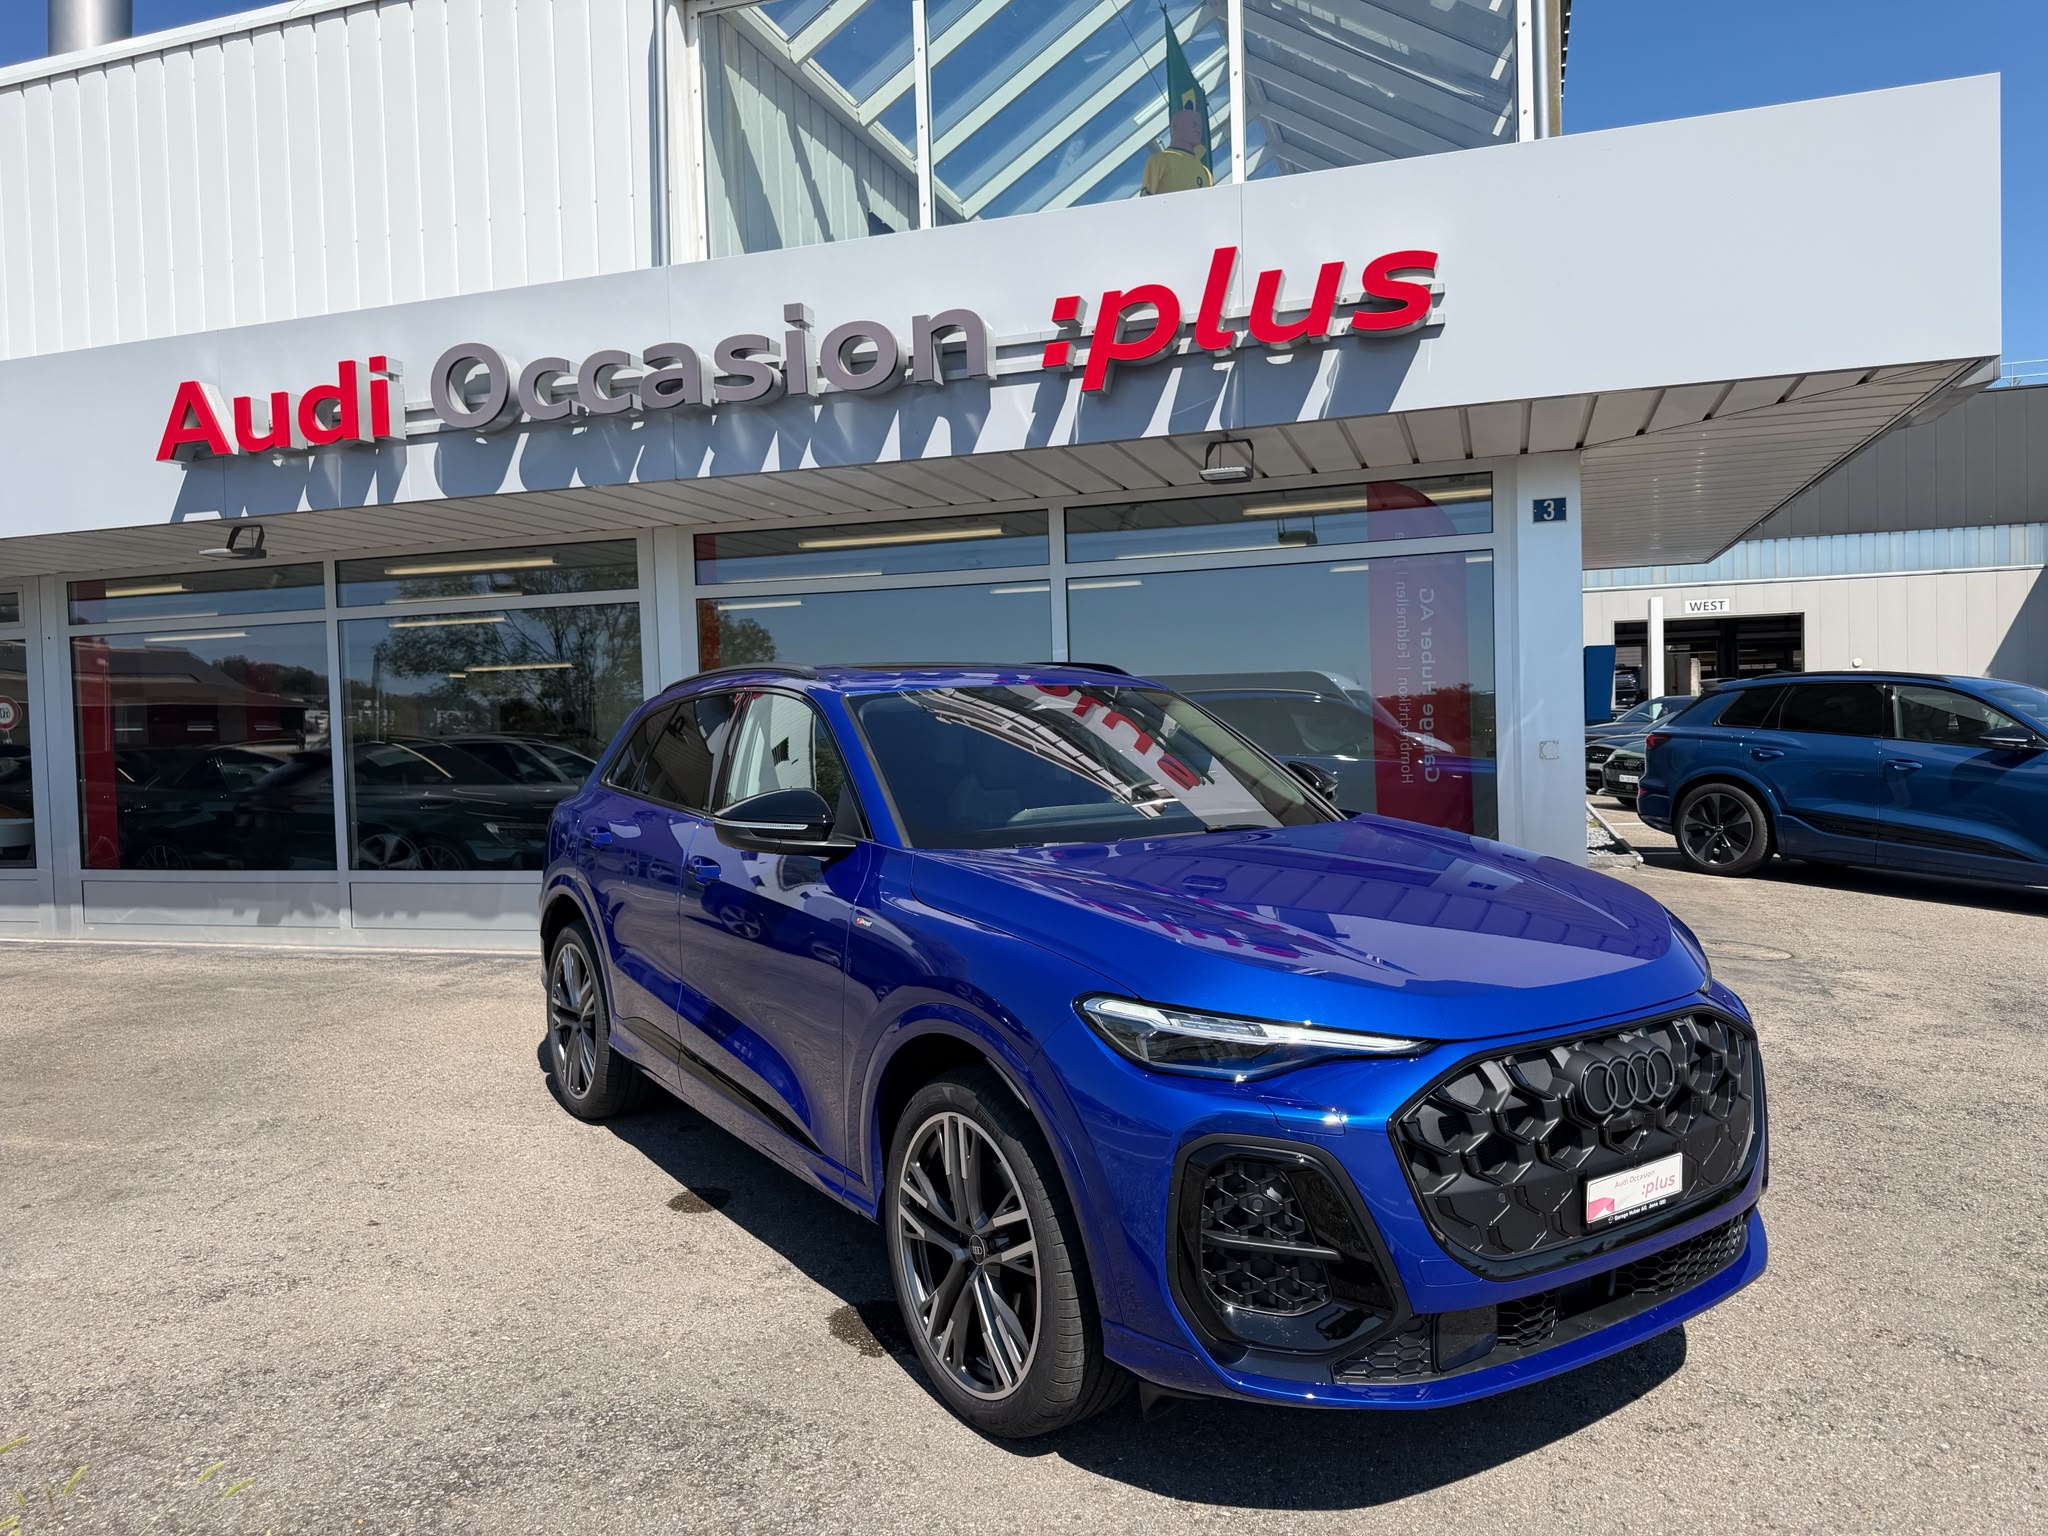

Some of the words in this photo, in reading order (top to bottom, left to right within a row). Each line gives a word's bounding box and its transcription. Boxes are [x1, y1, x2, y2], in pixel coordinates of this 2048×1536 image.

[156, 355, 396, 463] Audi
[430, 303, 993, 430] Occasion
[1543, 500, 1555, 520] 3
[1689, 600, 1726, 612] WEST
[1614, 1178, 1629, 1189] Audi
[1629, 1170, 1656, 1183] Occasion
